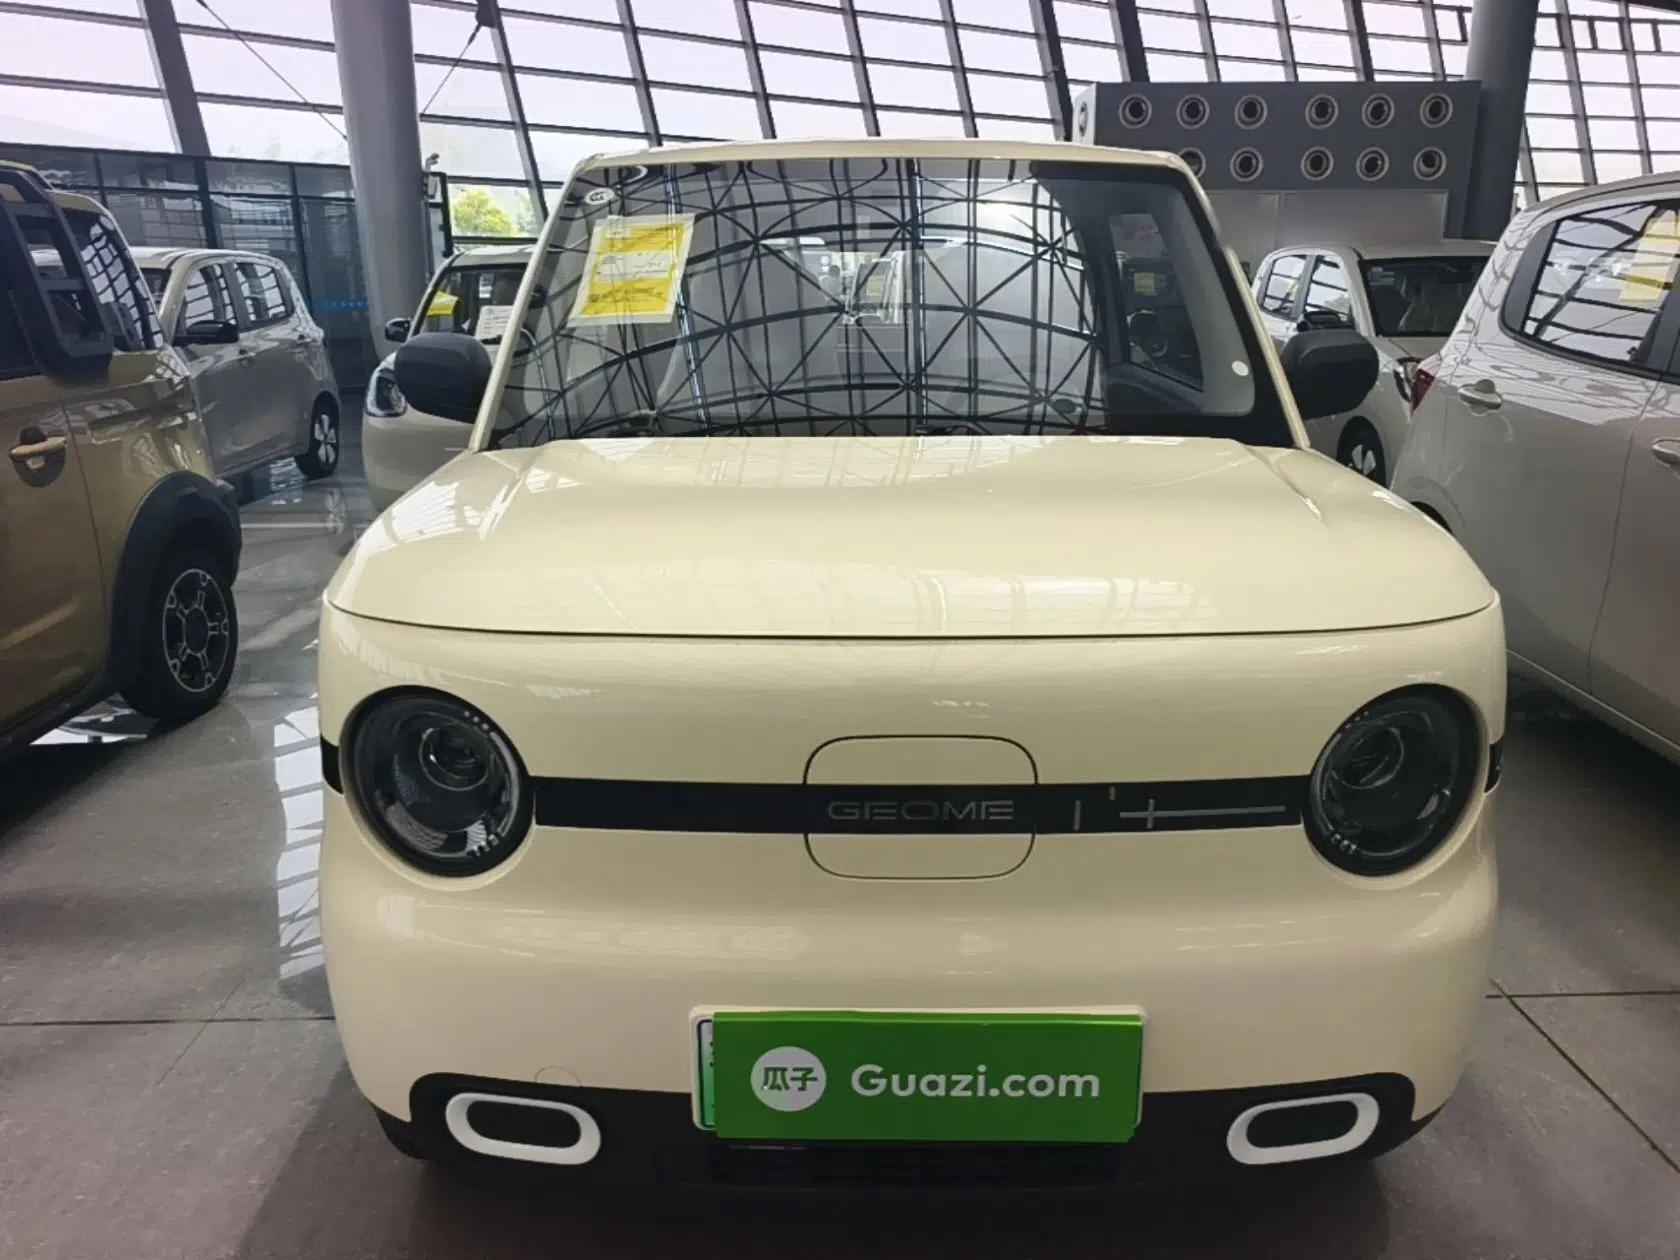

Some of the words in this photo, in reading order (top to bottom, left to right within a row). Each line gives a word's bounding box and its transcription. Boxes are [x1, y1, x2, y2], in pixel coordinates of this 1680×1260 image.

[827, 800, 1014, 821] GEOME
[762, 1066, 818, 1092] 瓜子
[851, 1064, 1101, 1098] Guazi.com
